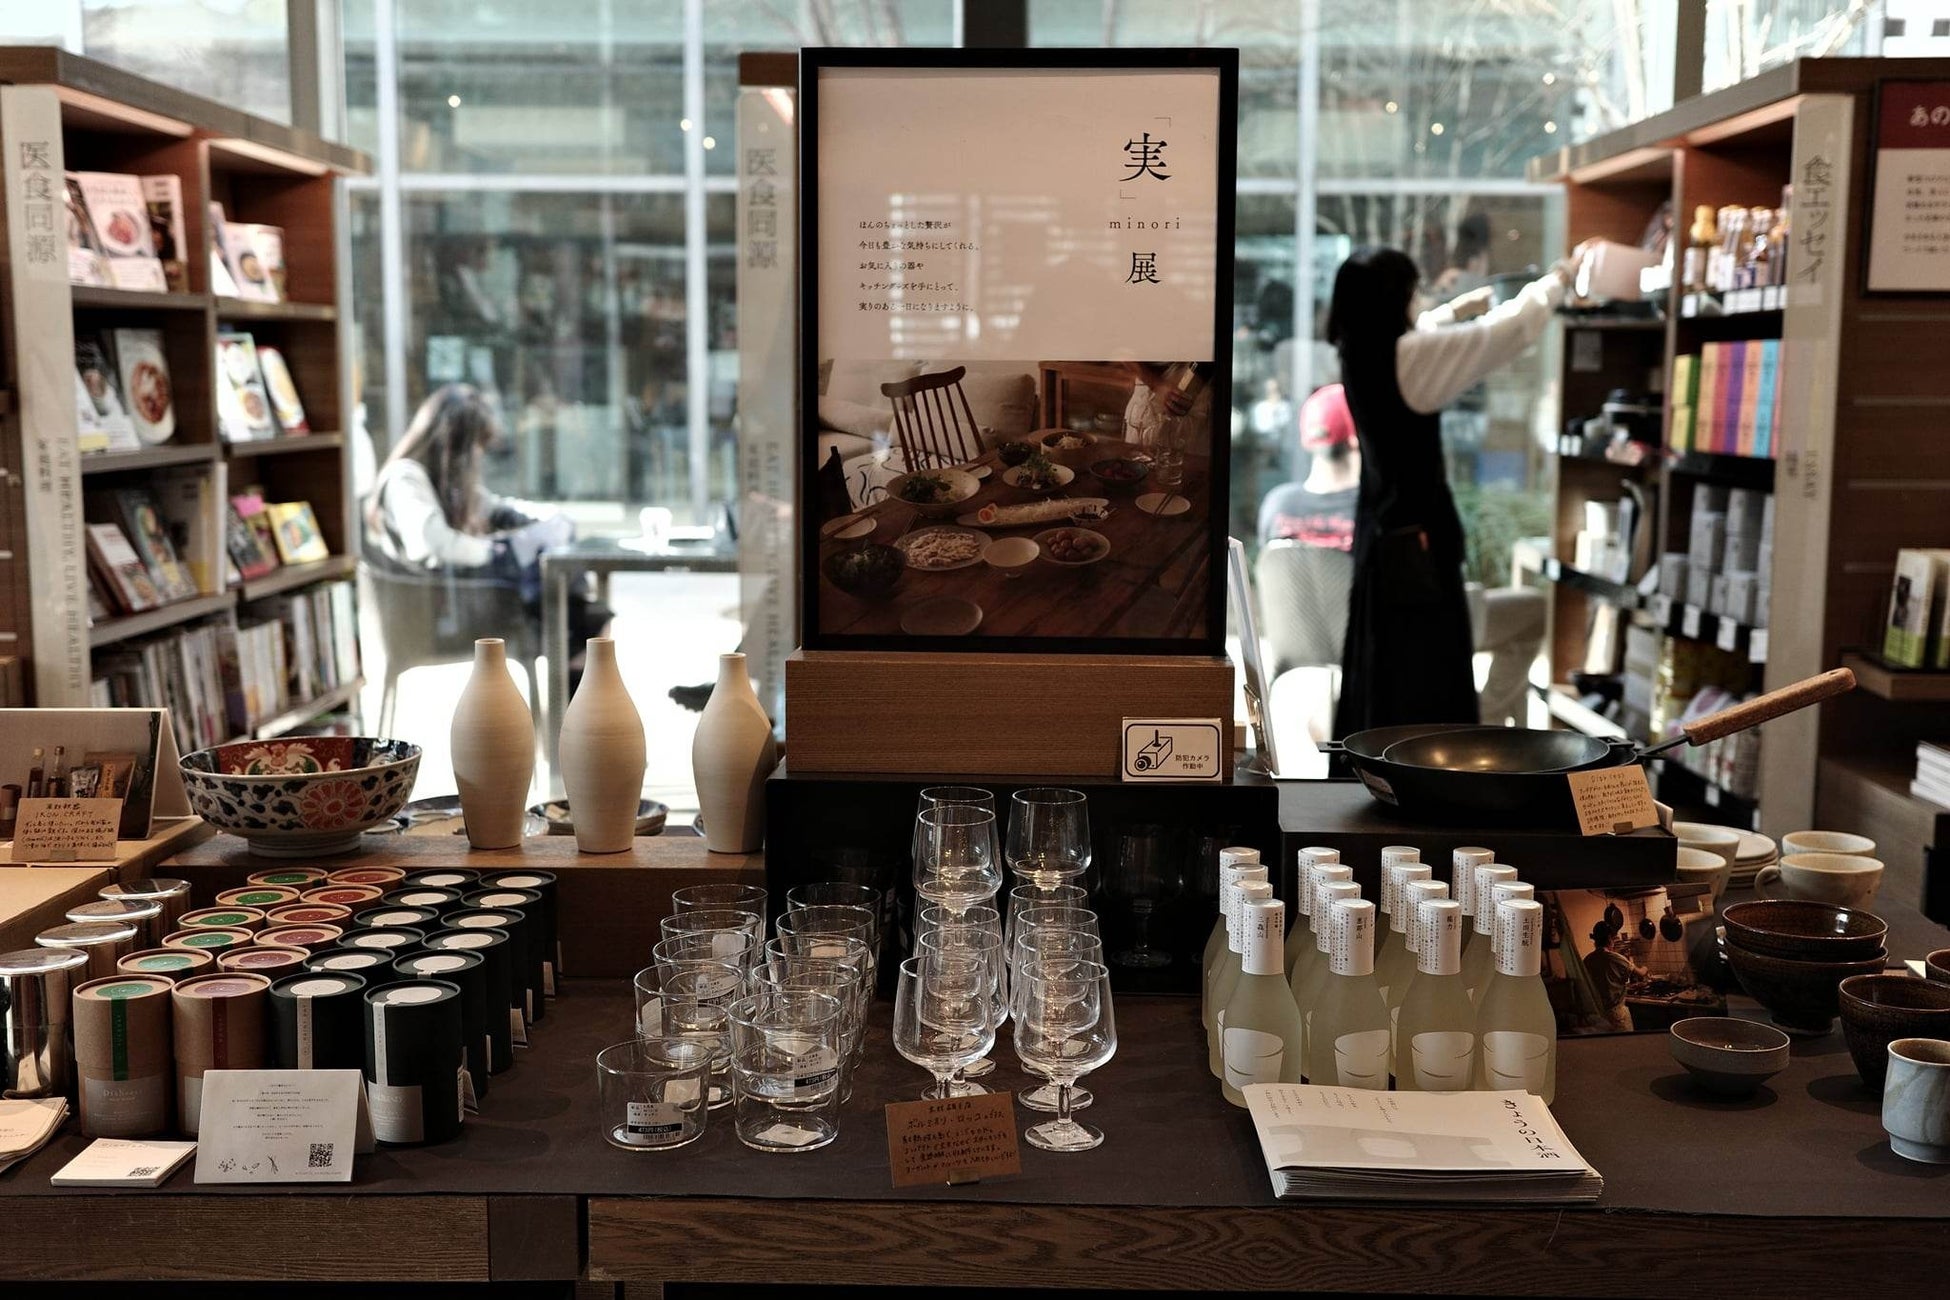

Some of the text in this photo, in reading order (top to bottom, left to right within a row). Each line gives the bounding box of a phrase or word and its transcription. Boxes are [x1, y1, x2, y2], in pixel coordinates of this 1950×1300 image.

[19, 140, 57, 266] 医食同源
[746, 148, 778, 269] 医食同源
[1797, 154, 1833, 286] 食エッセイ
[859, 220, 952, 230] ほんのちょっとした贅沢が
[1109, 216, 1182, 230] minori
[1125, 251, 1162, 285] 展
[1175, 754, 1210, 762] 防犯カメラ
